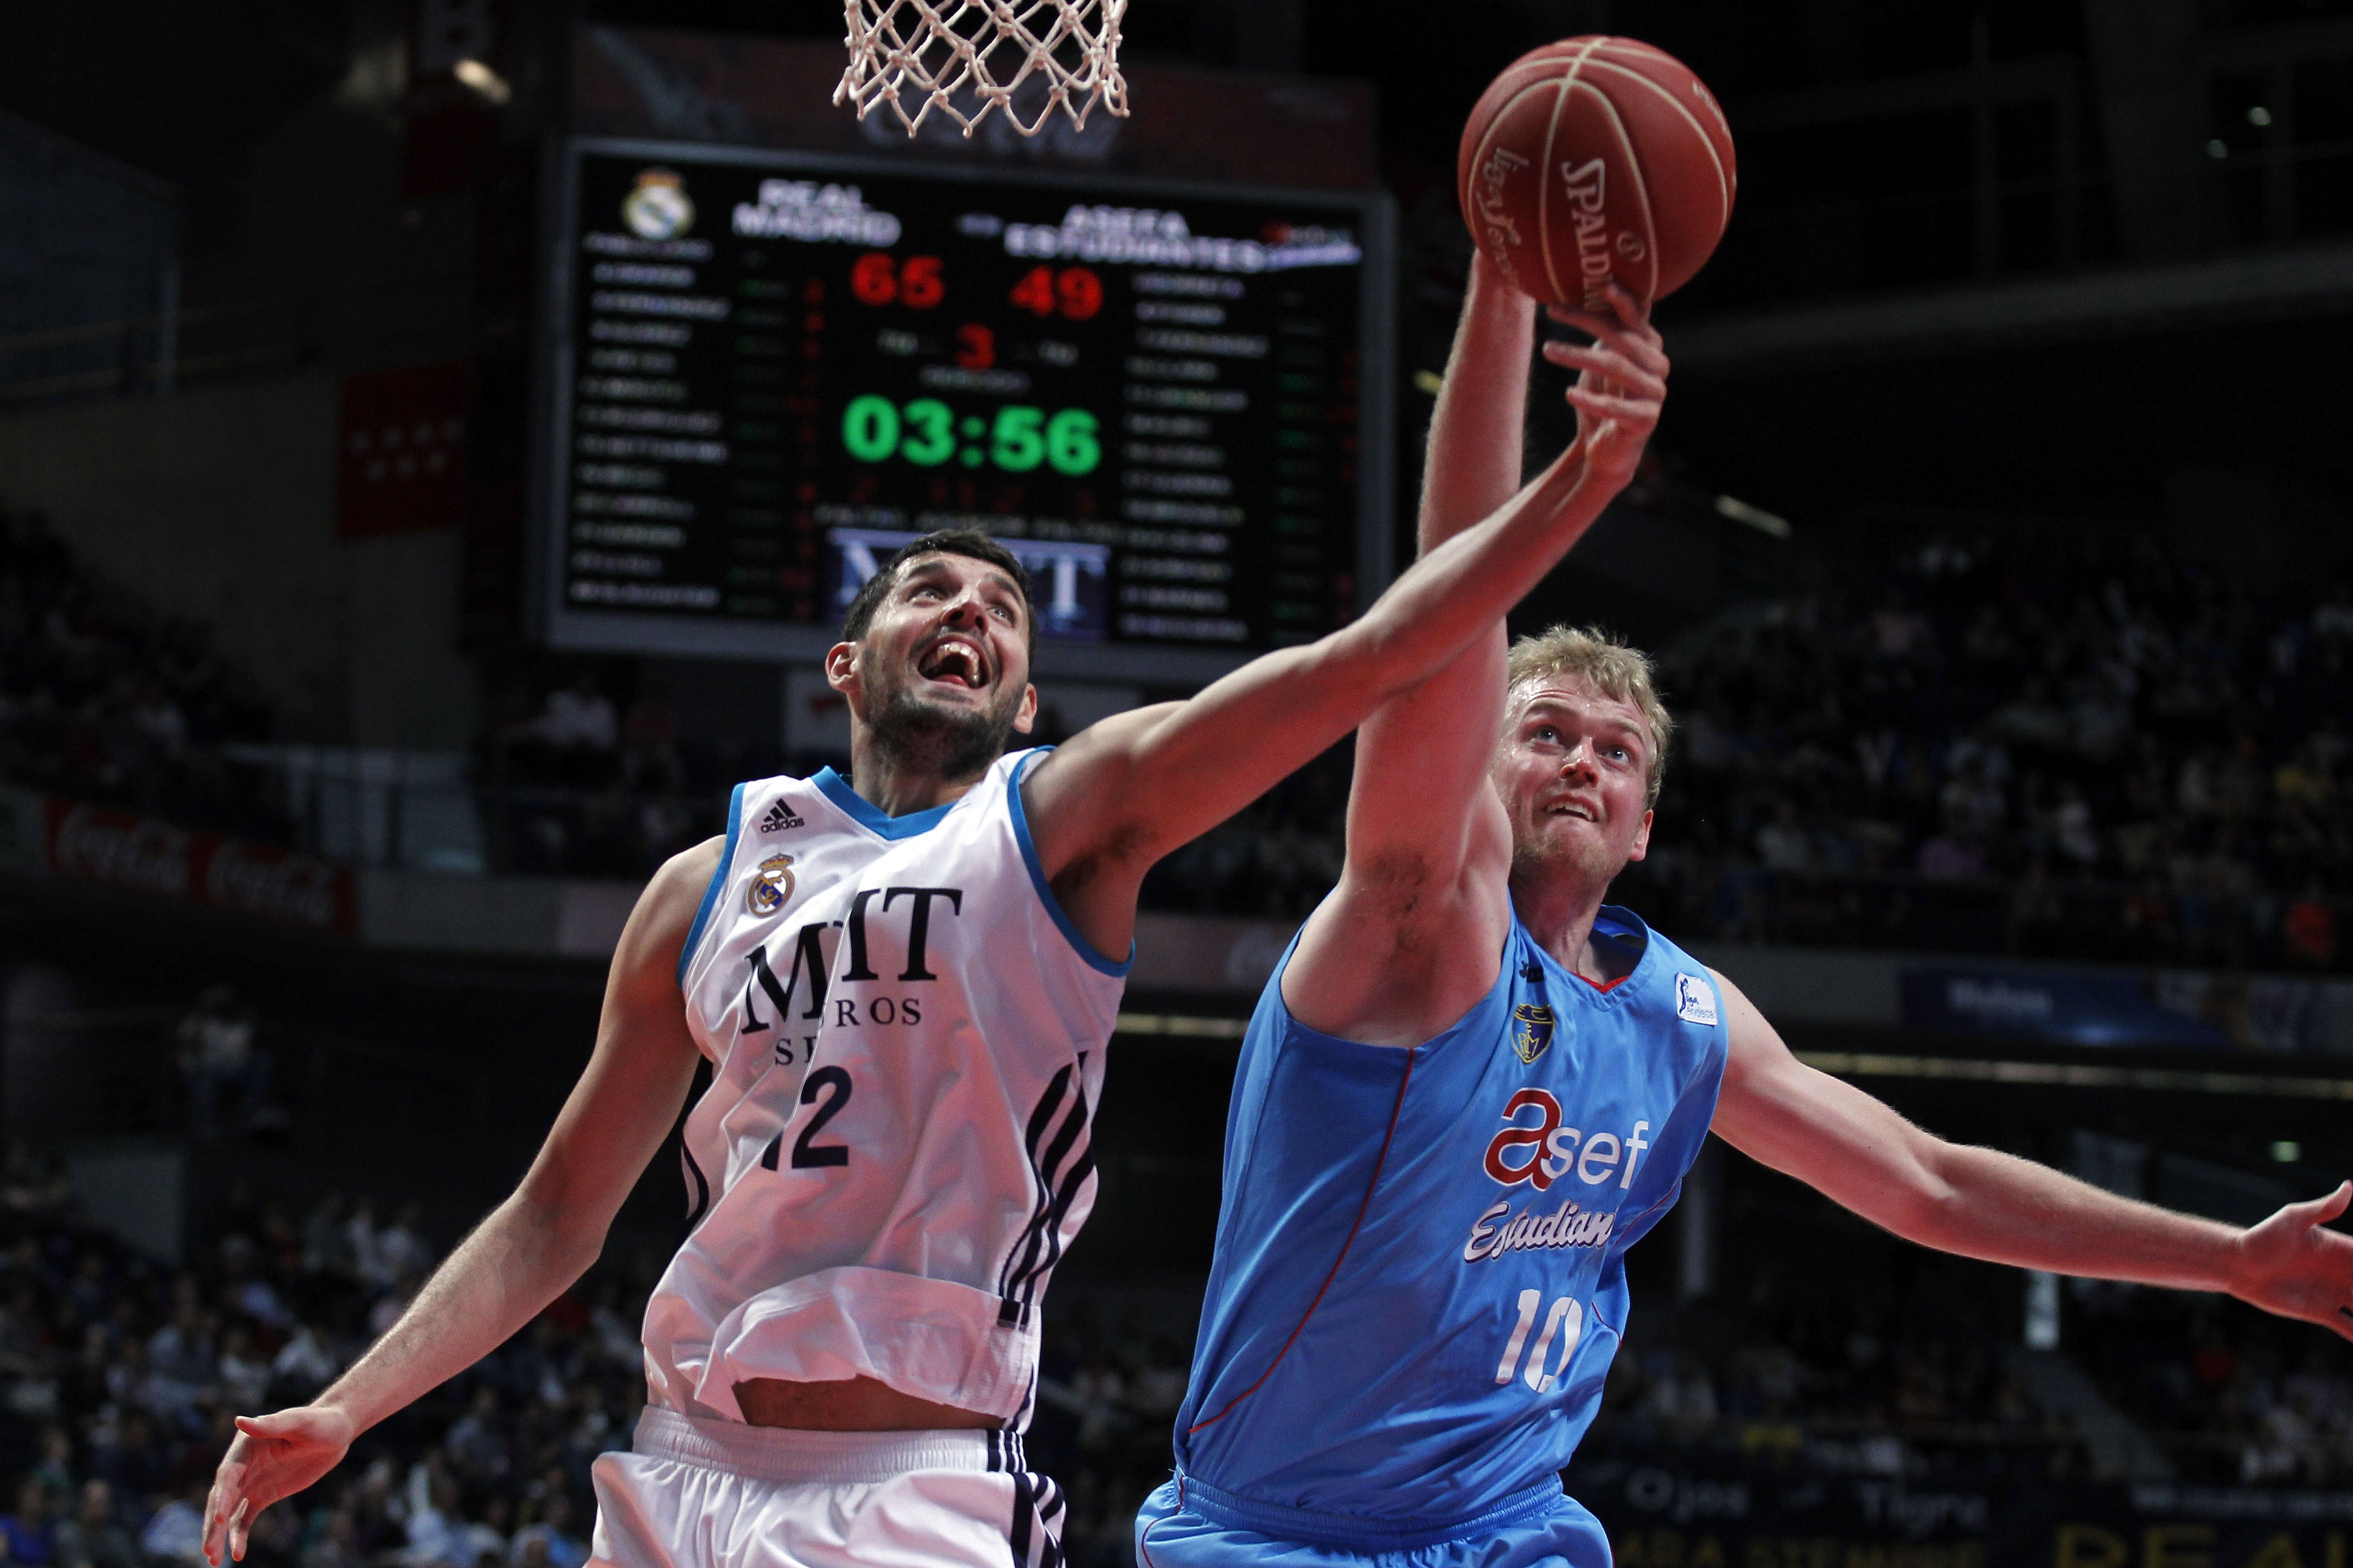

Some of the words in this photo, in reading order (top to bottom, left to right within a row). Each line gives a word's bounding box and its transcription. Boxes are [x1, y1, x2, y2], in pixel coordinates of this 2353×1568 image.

[850, 251, 947, 310] 65
[1008, 263, 1105, 321] 49
[954, 322, 997, 370] 3
[840, 393, 1102, 477] 03:56
[761, 816, 805, 834] adidas
[742, 887, 963, 1035] MIT
[1483, 1086, 1649, 1192] asef
[1494, 1288, 1584, 1394] 10
